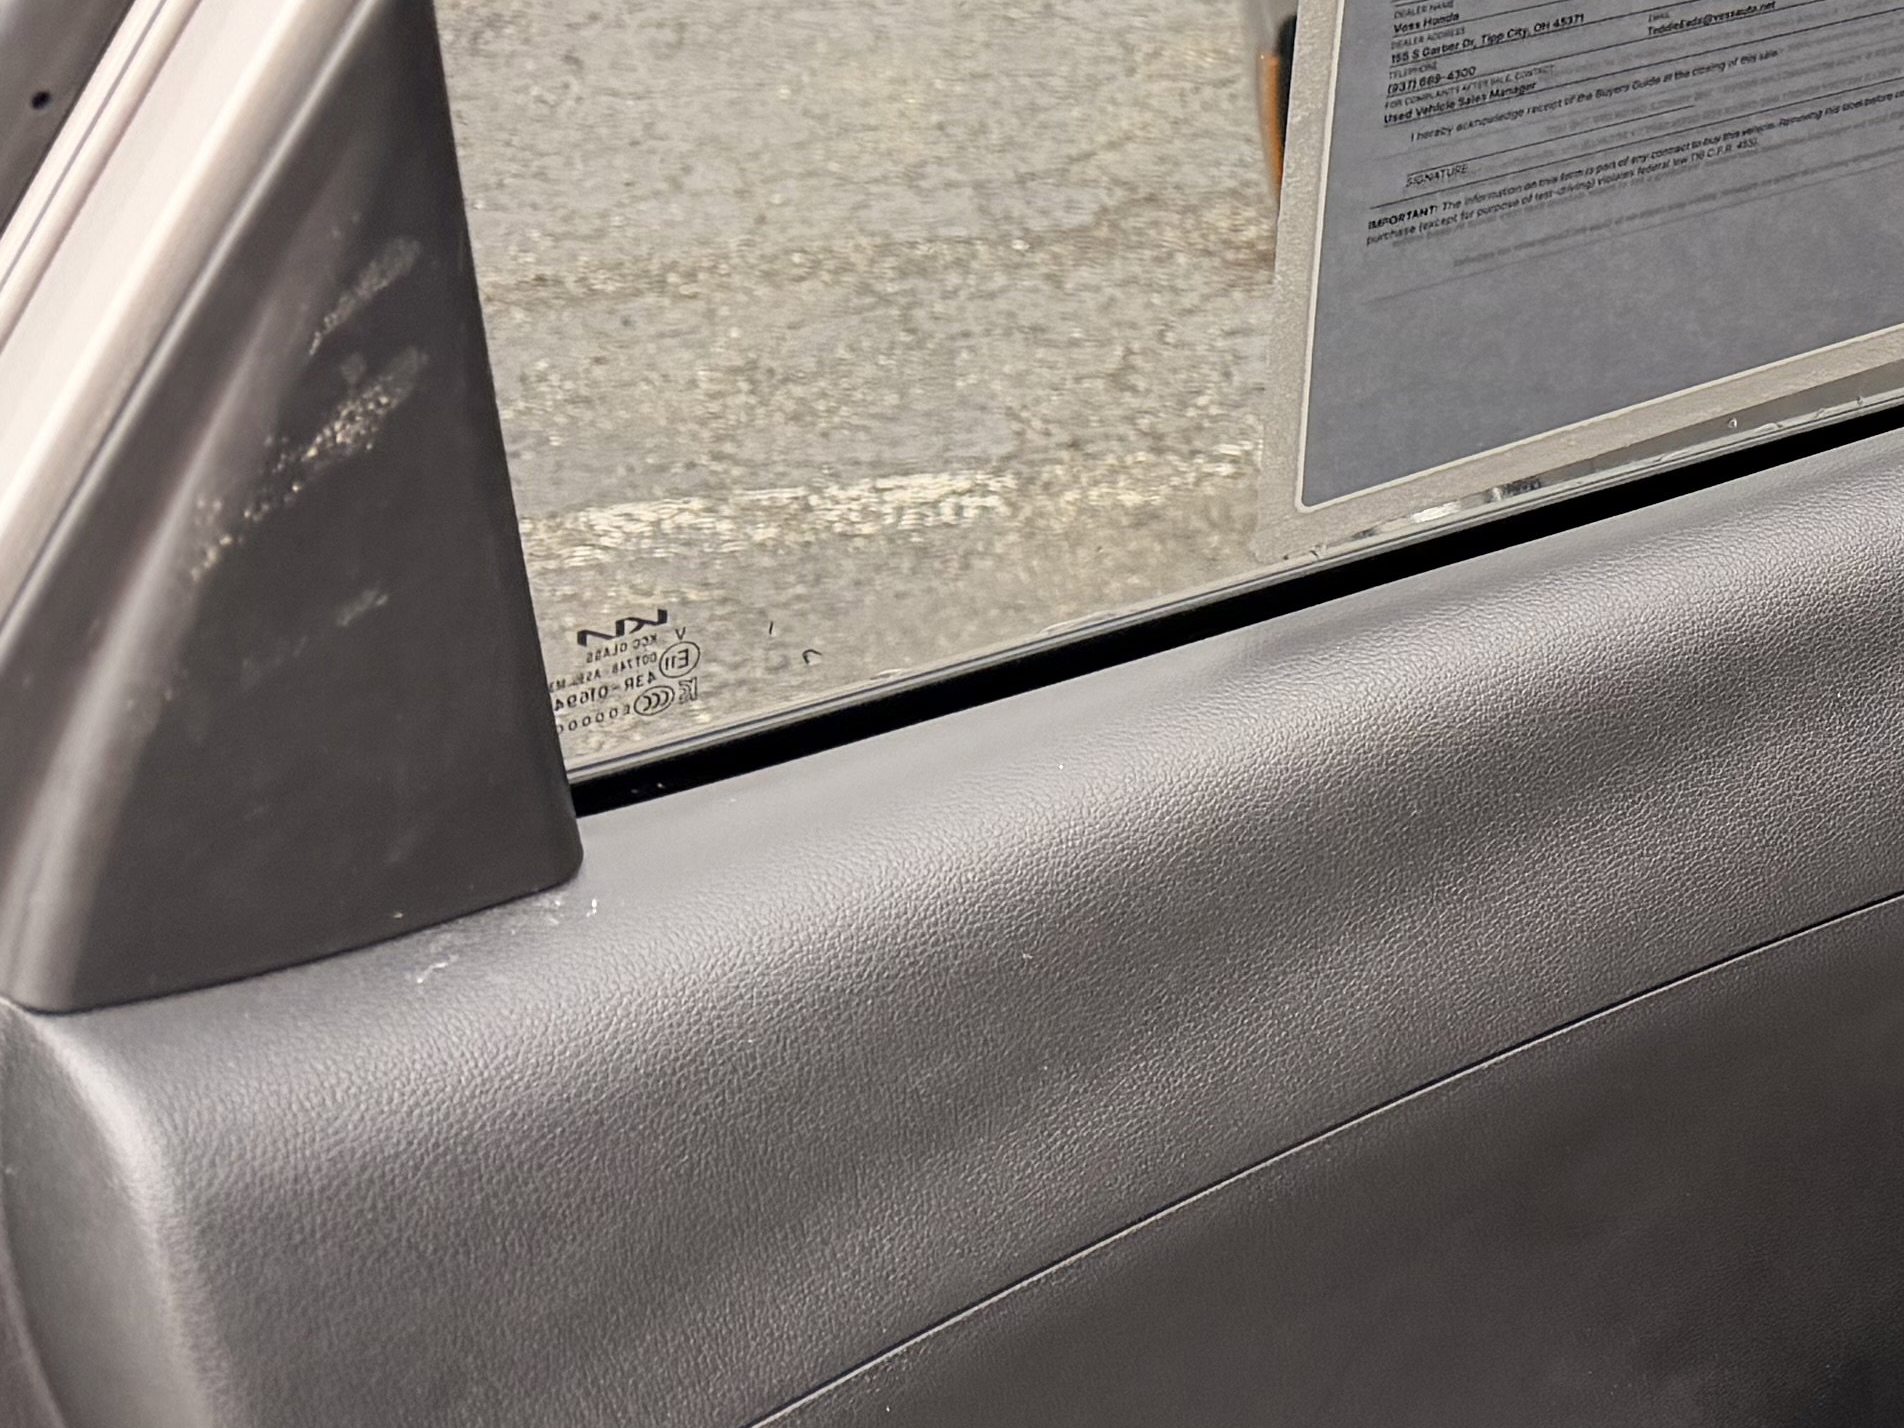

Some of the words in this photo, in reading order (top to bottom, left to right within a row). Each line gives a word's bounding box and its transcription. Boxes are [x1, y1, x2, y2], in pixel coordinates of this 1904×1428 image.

[1479, 29, 1505, 46] Tipp
[1505, 24, 1531, 41] City,
[1551, 12, 1585, 28] 45371
[1383, 107, 1413, 123] Used
[1414, 97, 1456, 116] Vehicle
[1456, 91, 1487, 107] Sales
[1487, 80, 1537, 102] Manager
[1386, 78, 1417, 97] (937)
